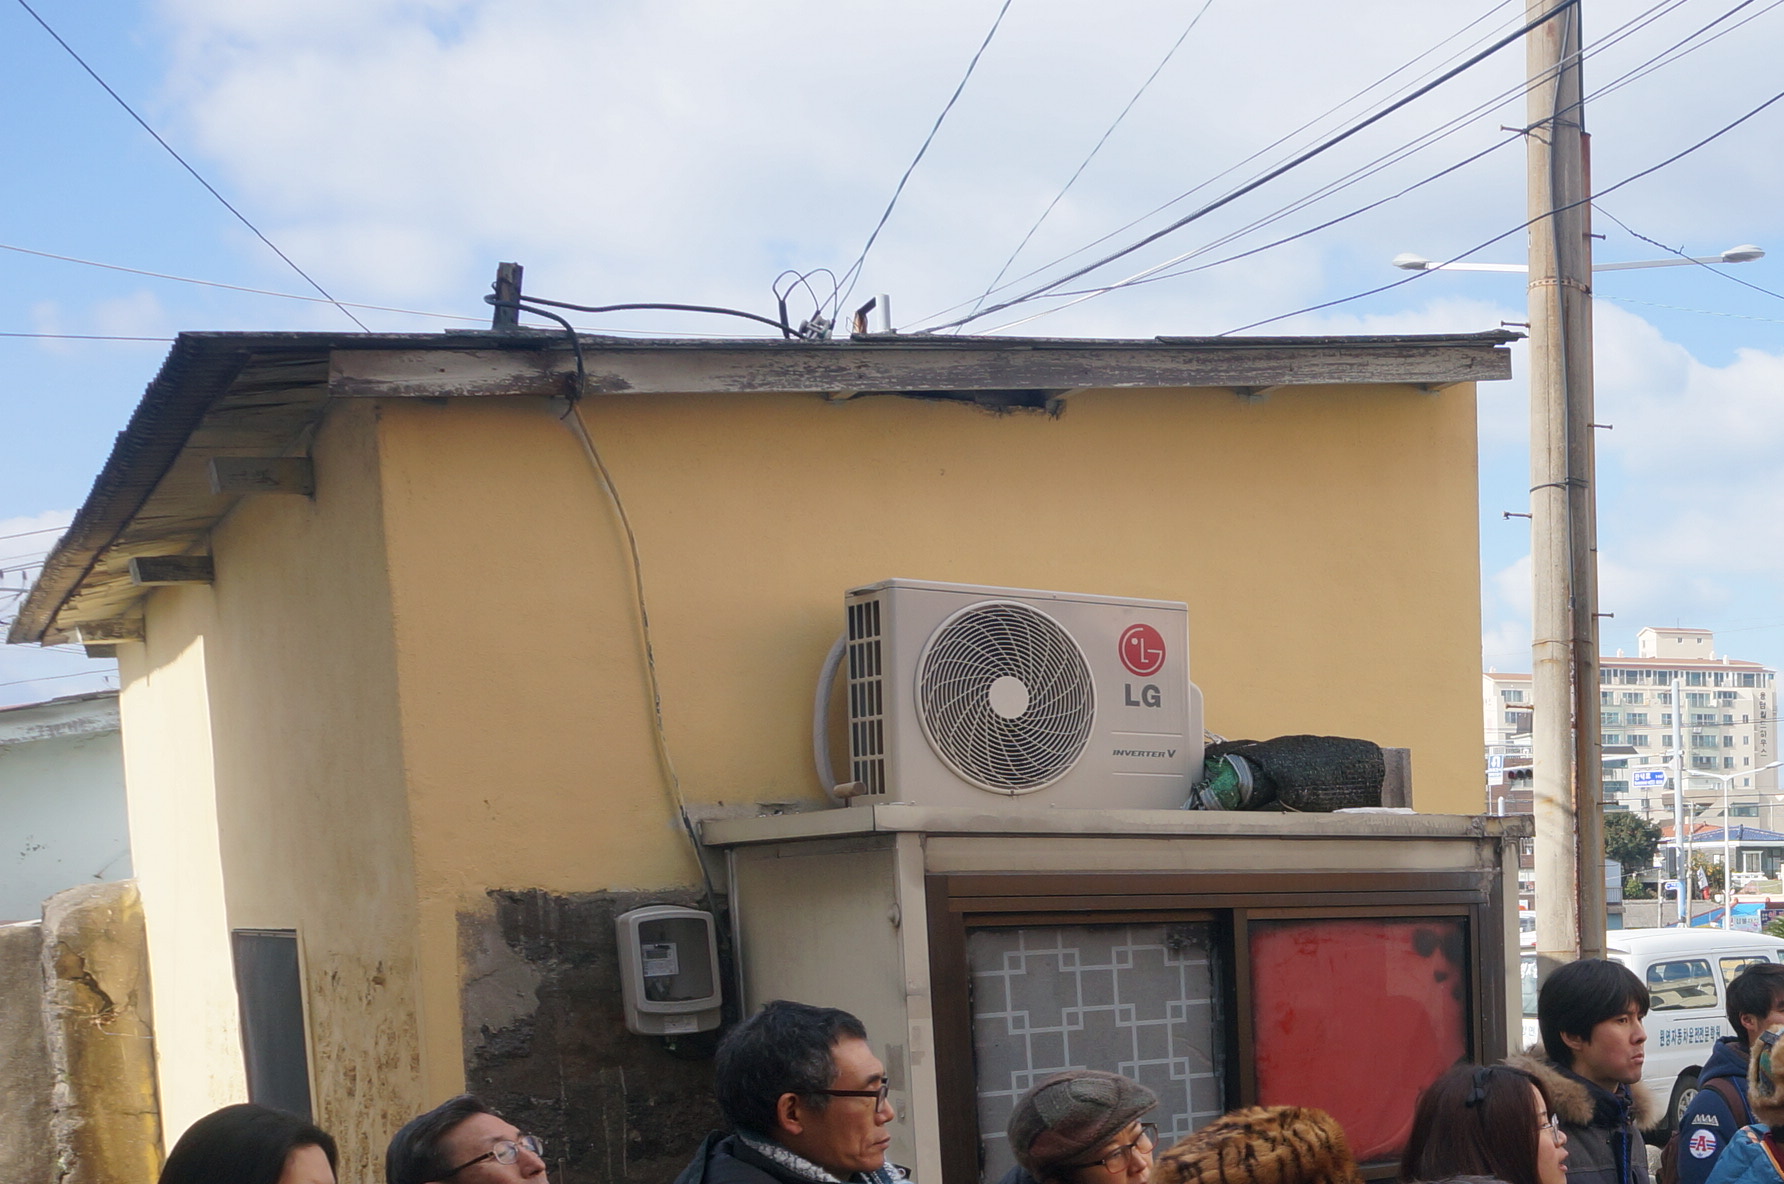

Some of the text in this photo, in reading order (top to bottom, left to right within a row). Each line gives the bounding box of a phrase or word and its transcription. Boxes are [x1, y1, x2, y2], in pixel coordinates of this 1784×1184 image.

[1124, 683, 1161, 708] LG
[1112, 749, 1177, 759] INVERTER V
[1695, 1135, 1707, 1151] A
